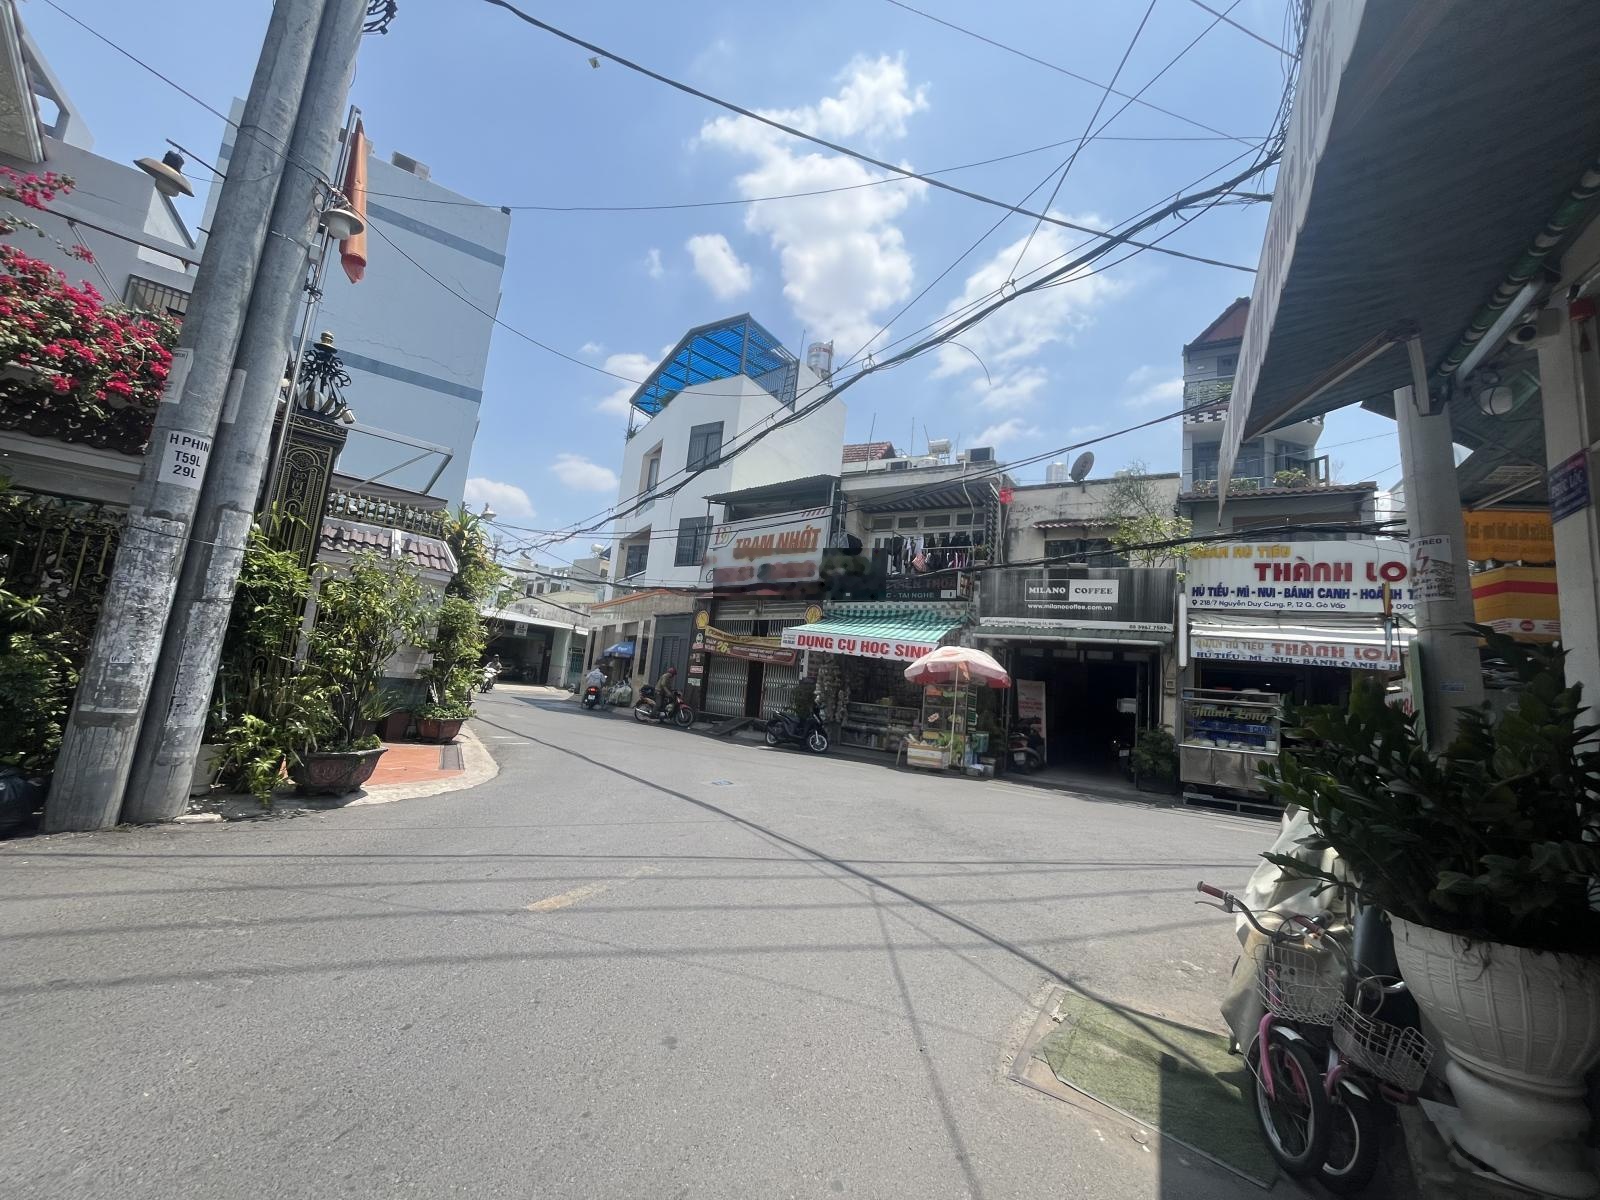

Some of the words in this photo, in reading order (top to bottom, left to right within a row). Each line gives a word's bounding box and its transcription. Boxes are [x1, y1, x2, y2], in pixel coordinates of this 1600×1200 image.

[170, 434, 179, 444] H
[175, 450, 201, 467] T59L
[173, 465, 196, 478] 29L
[1254, 555, 1353, 582] THÀNH
[1028, 586, 1066, 594] MILANO
[1074, 587, 1113, 595] COFFEE
[1207, 581, 1229, 598] TIẾU
[1257, 587, 1276, 598] NUI
[1284, 585, 1314, 599] BÁNH
[1317, 587, 1350, 599] CANH
[1247, 600, 1262, 608] Duy
[796, 634, 834, 650] DỤNG
[837, 638, 857, 654] CỤ
[860, 640, 890, 657] HỌC
[1341, 660, 1377, 669] CANH
